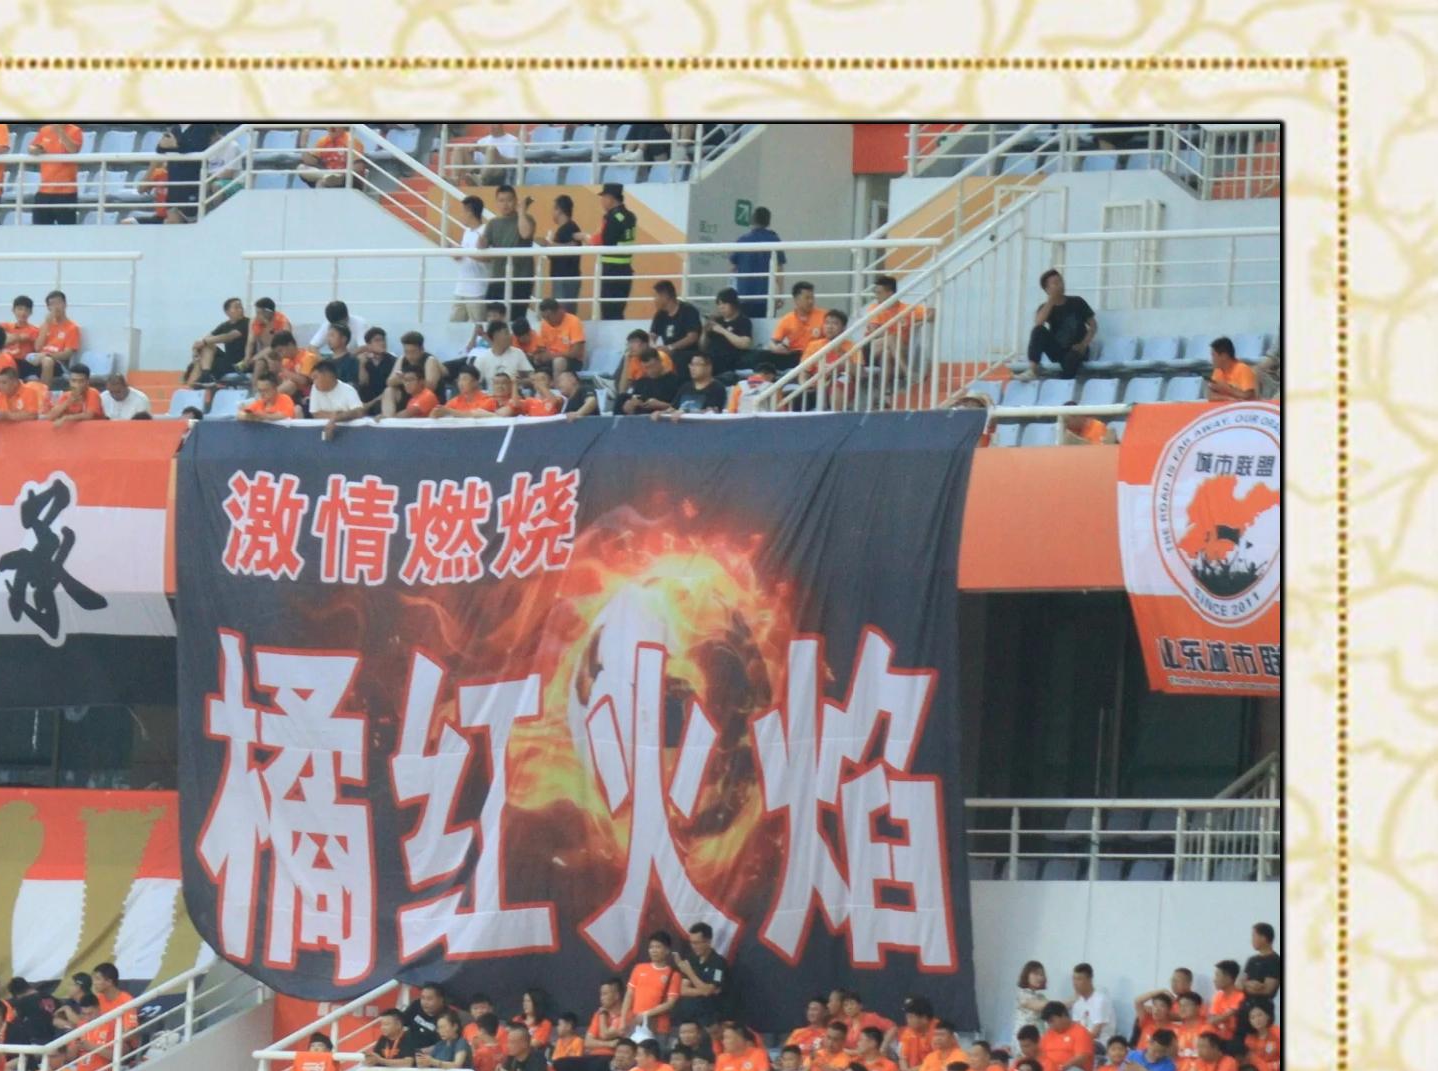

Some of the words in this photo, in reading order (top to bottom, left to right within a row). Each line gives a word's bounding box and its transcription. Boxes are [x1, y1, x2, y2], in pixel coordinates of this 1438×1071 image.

[1195, 452, 1276, 477] 城市联盟
[221, 466, 582, 586] 激情燃烧
[1193, 587, 1228, 616] SINCE
[197, 627, 957, 984] 橘红火焰
